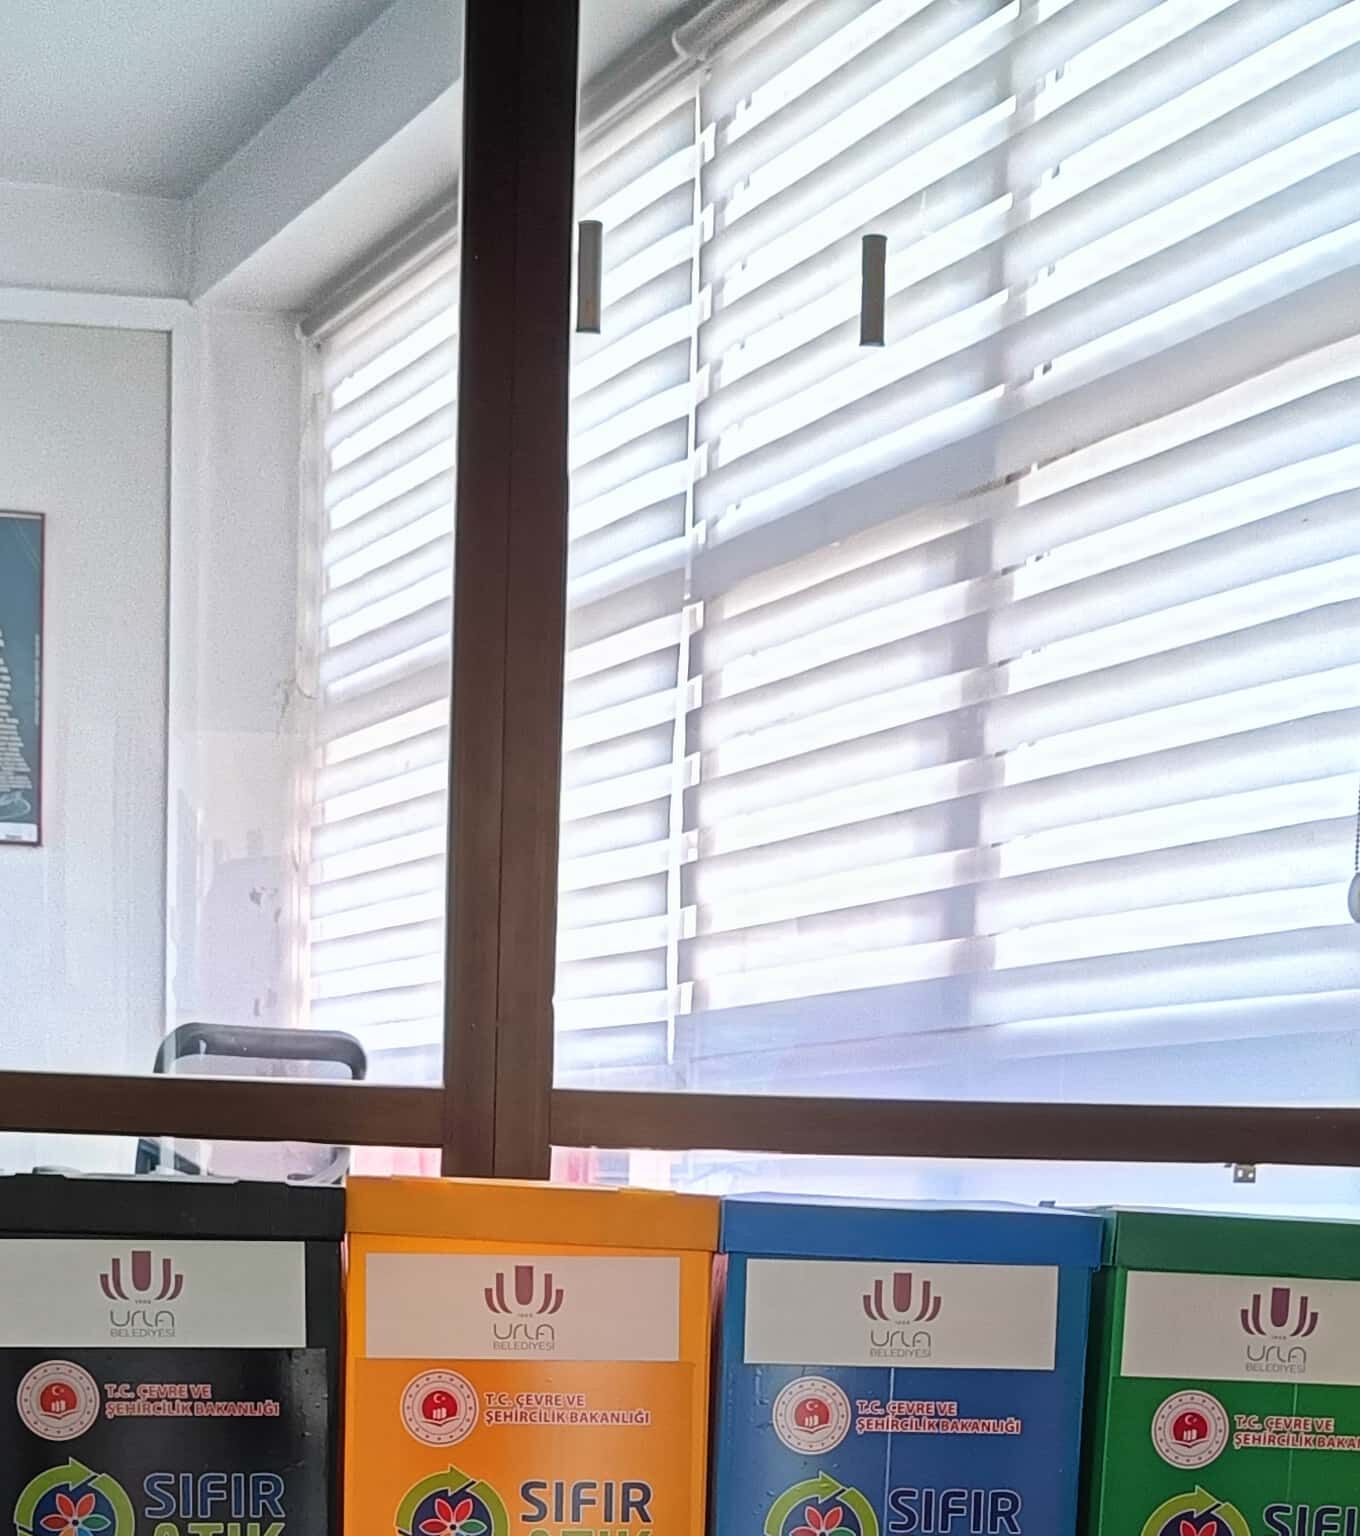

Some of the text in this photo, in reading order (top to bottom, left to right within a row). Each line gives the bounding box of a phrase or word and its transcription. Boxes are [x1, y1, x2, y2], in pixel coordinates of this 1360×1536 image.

[105, 1384, 212, 1400] T.C. ÇEVRE VE
[484, 1393, 585, 1408] T.C. ÇEVRE VE
[106, 1399, 280, 1419] ŞEHİRCİLİK BAKANLIĞI
[485, 1408, 651, 1426] ŞEHİRCİLİK BAKANLIĞI
[856, 1400, 958, 1417] T.C. ÇEVRE VE
[857, 1416, 1022, 1435] ŞEHİRCİLİK BAKANLIĞI
[1234, 1415, 1334, 1432] T.C. ÇEVRE VE
[1234, 1431, 1317, 1450] ŞEHİRCİLİK
[143, 1472, 286, 1519] SIFIR
[520, 1480, 653, 1523] SIFIR
[888, 1488, 1022, 1534] SIFIR
